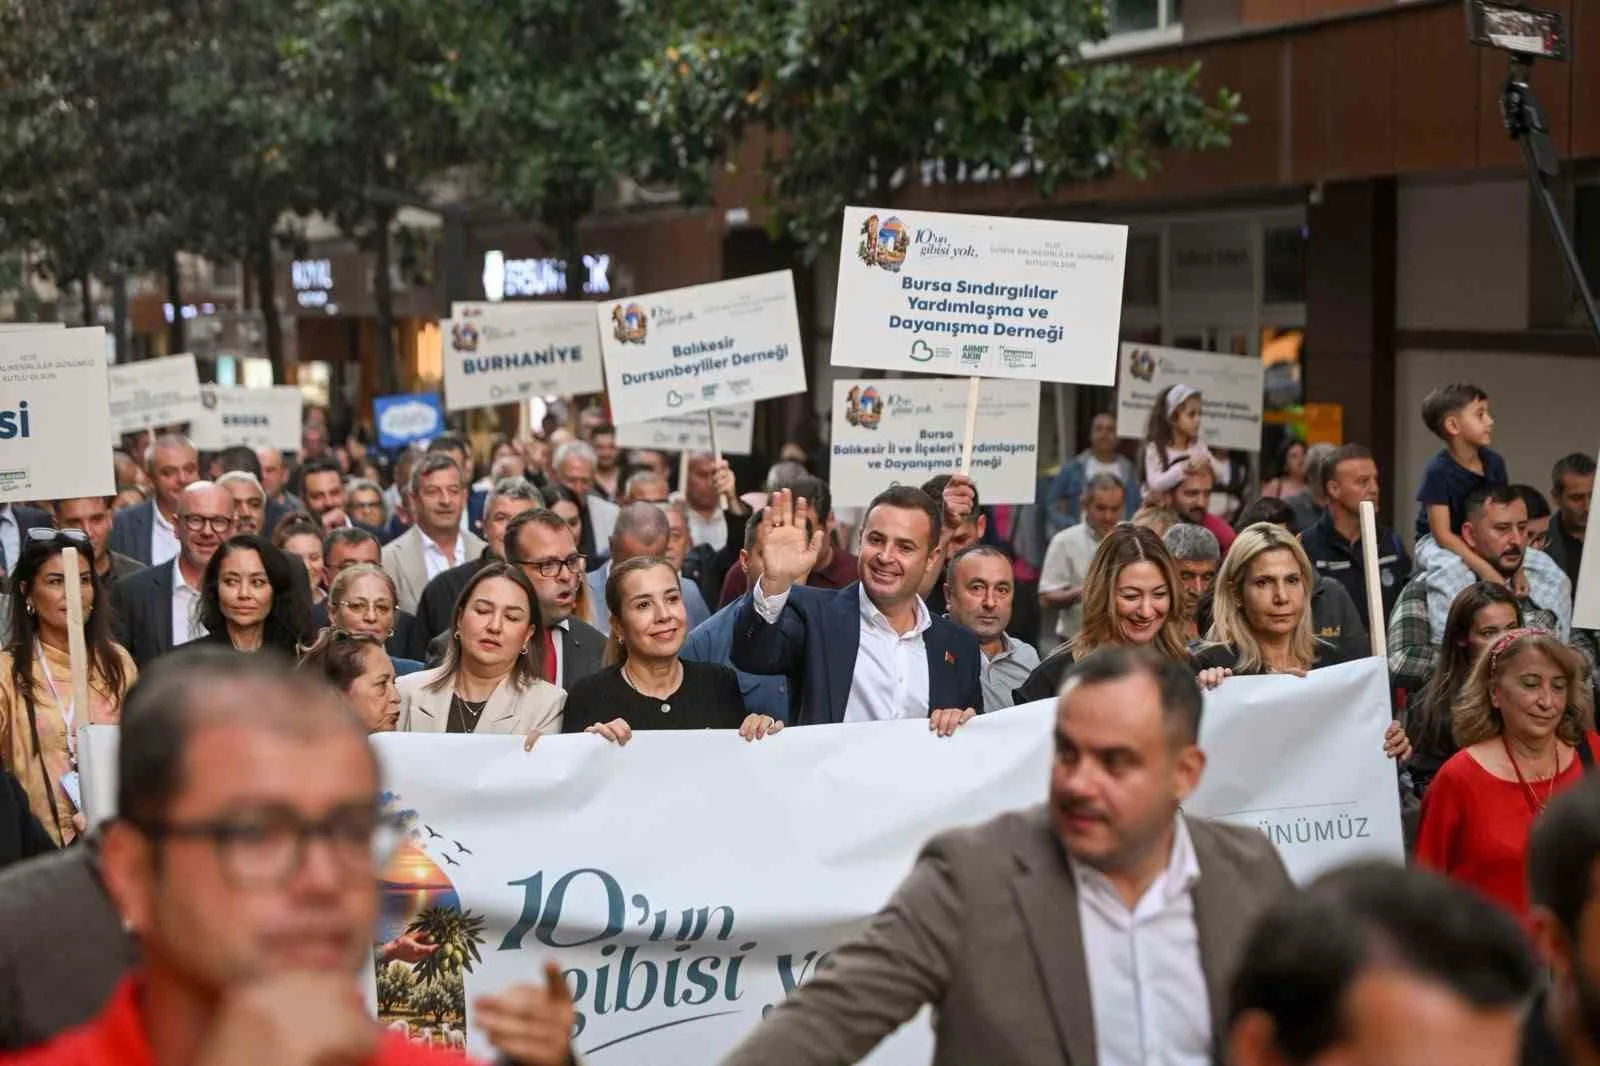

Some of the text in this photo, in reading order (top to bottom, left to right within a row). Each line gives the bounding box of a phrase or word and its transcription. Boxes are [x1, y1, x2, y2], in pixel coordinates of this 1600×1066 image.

[902, 277, 1058, 300] Bursa Sındırgılılar
[907, 297, 1049, 320] Yardımlaşma ve
[889, 316, 1064, 342] Dayanışma Derneği
[672, 336, 735, 358] Balıkesir
[463, 344, 582, 375] BURHANİYE
[622, 357, 728, 386] Dursunbeyliler
[732, 344, 789, 366] Derneği
[0, 400, 30, 439] si
[919, 429, 954, 440] Bursa
[833, 442, 885, 455] Balıkesir
[898, 445, 911, 454] ve
[915, 442, 956, 457] İlçeleri
[867, 457, 1002, 472] ve Dayanışma Drneği
[1257, 813, 1370, 844] ÜNÜMÜZ
